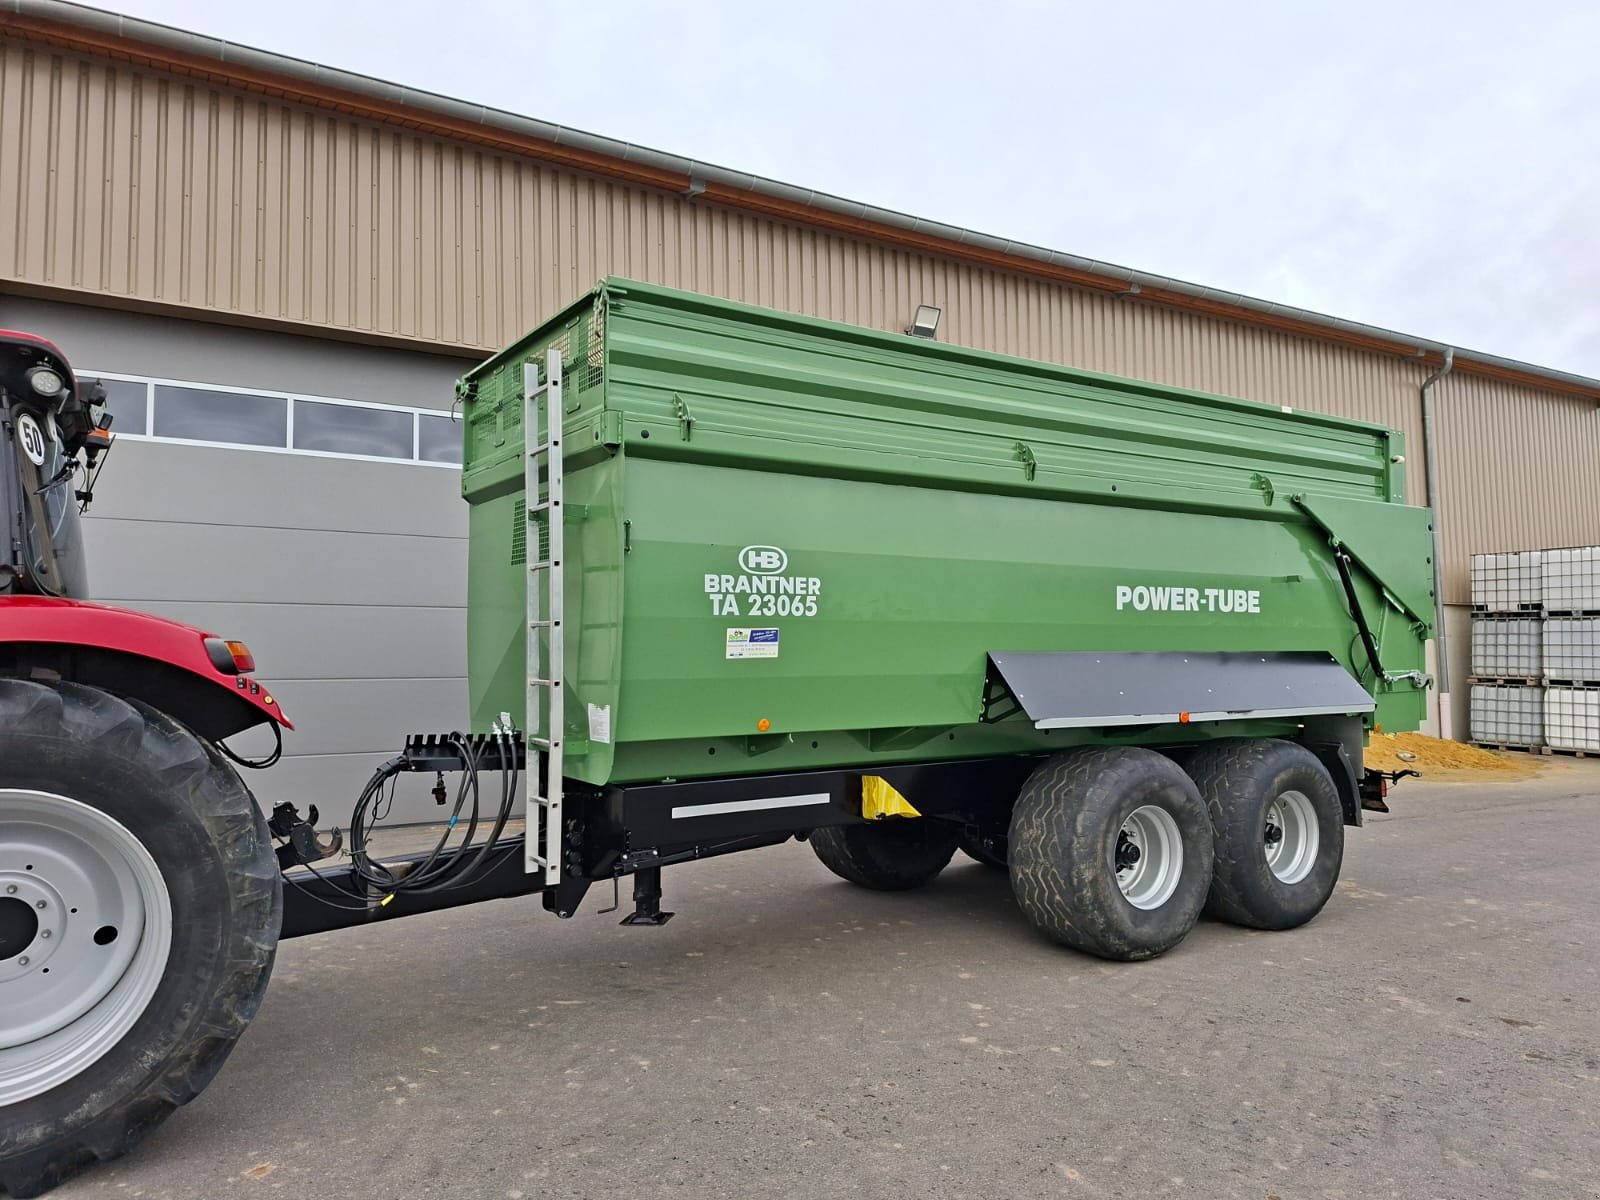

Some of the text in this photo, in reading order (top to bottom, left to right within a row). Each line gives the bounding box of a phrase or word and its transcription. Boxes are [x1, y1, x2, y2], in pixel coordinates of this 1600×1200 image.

[22, 421, 43, 458] 50
[748, 550, 781, 569] HB
[704, 573, 822, 596] BRANTNER
[709, 593, 818, 617] TA 23065
[1116, 585, 1261, 613] POWER-TUBE
